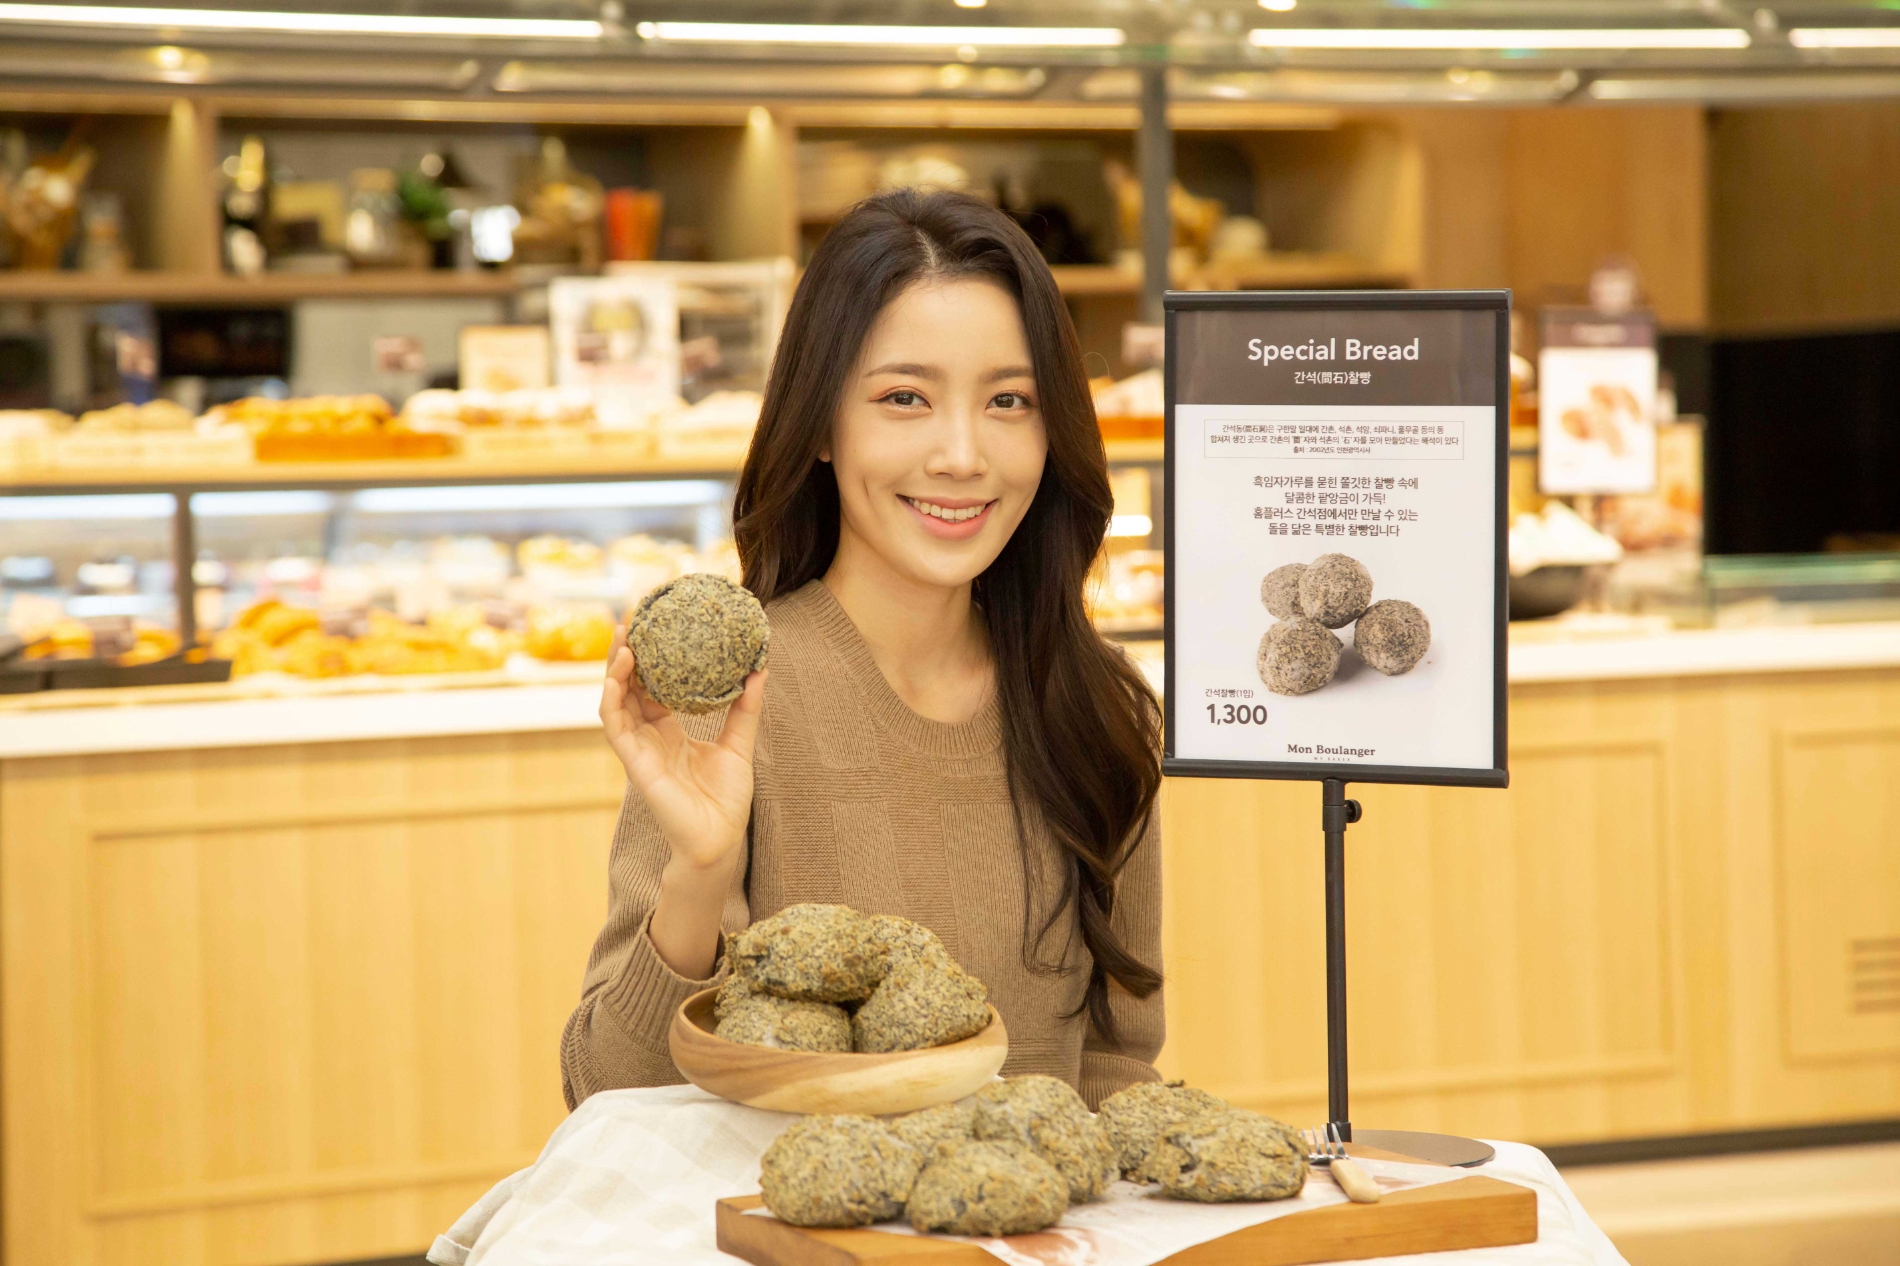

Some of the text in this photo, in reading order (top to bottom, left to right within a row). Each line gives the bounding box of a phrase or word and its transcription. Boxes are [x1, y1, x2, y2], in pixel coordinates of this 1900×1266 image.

[1248, 337, 1420, 367] Special Bread
[1298, 425, 1319, 434] 일대에
[1232, 435, 1246, 444] 생긴
[1247, 435, 1268, 444] 곳으로
[1303, 436, 1317, 445] 자와
[1353, 436, 1367, 445] 자를
[1369, 437, 1383, 445] 모아
[1384, 437, 1420, 446] 만들었다는
[1421, 437, 1443, 446] 해석이
[1444, 437, 1459, 446] 있다
[1293, 446, 1305, 454] 출처
[1309, 446, 1335, 454] 2002년도
[1253, 475, 1419, 490] 흑임자가루를 묻힌 쫄깃한 찰빵 속에
[1285, 491, 1386, 505] 달콤한 팥앙금이 가득!
[1253, 507, 1419, 522] 홈플러스 간석점에서만 만날 수 있는
[1268, 522, 1400, 537] 돌을 닮은 특별한 찰빵입니다
[1205, 688, 1254, 698] 간석찰빵(1입)
[1207, 703, 1268, 725] 1,300
[1287, 744, 1376, 758] Mon Boulanger
